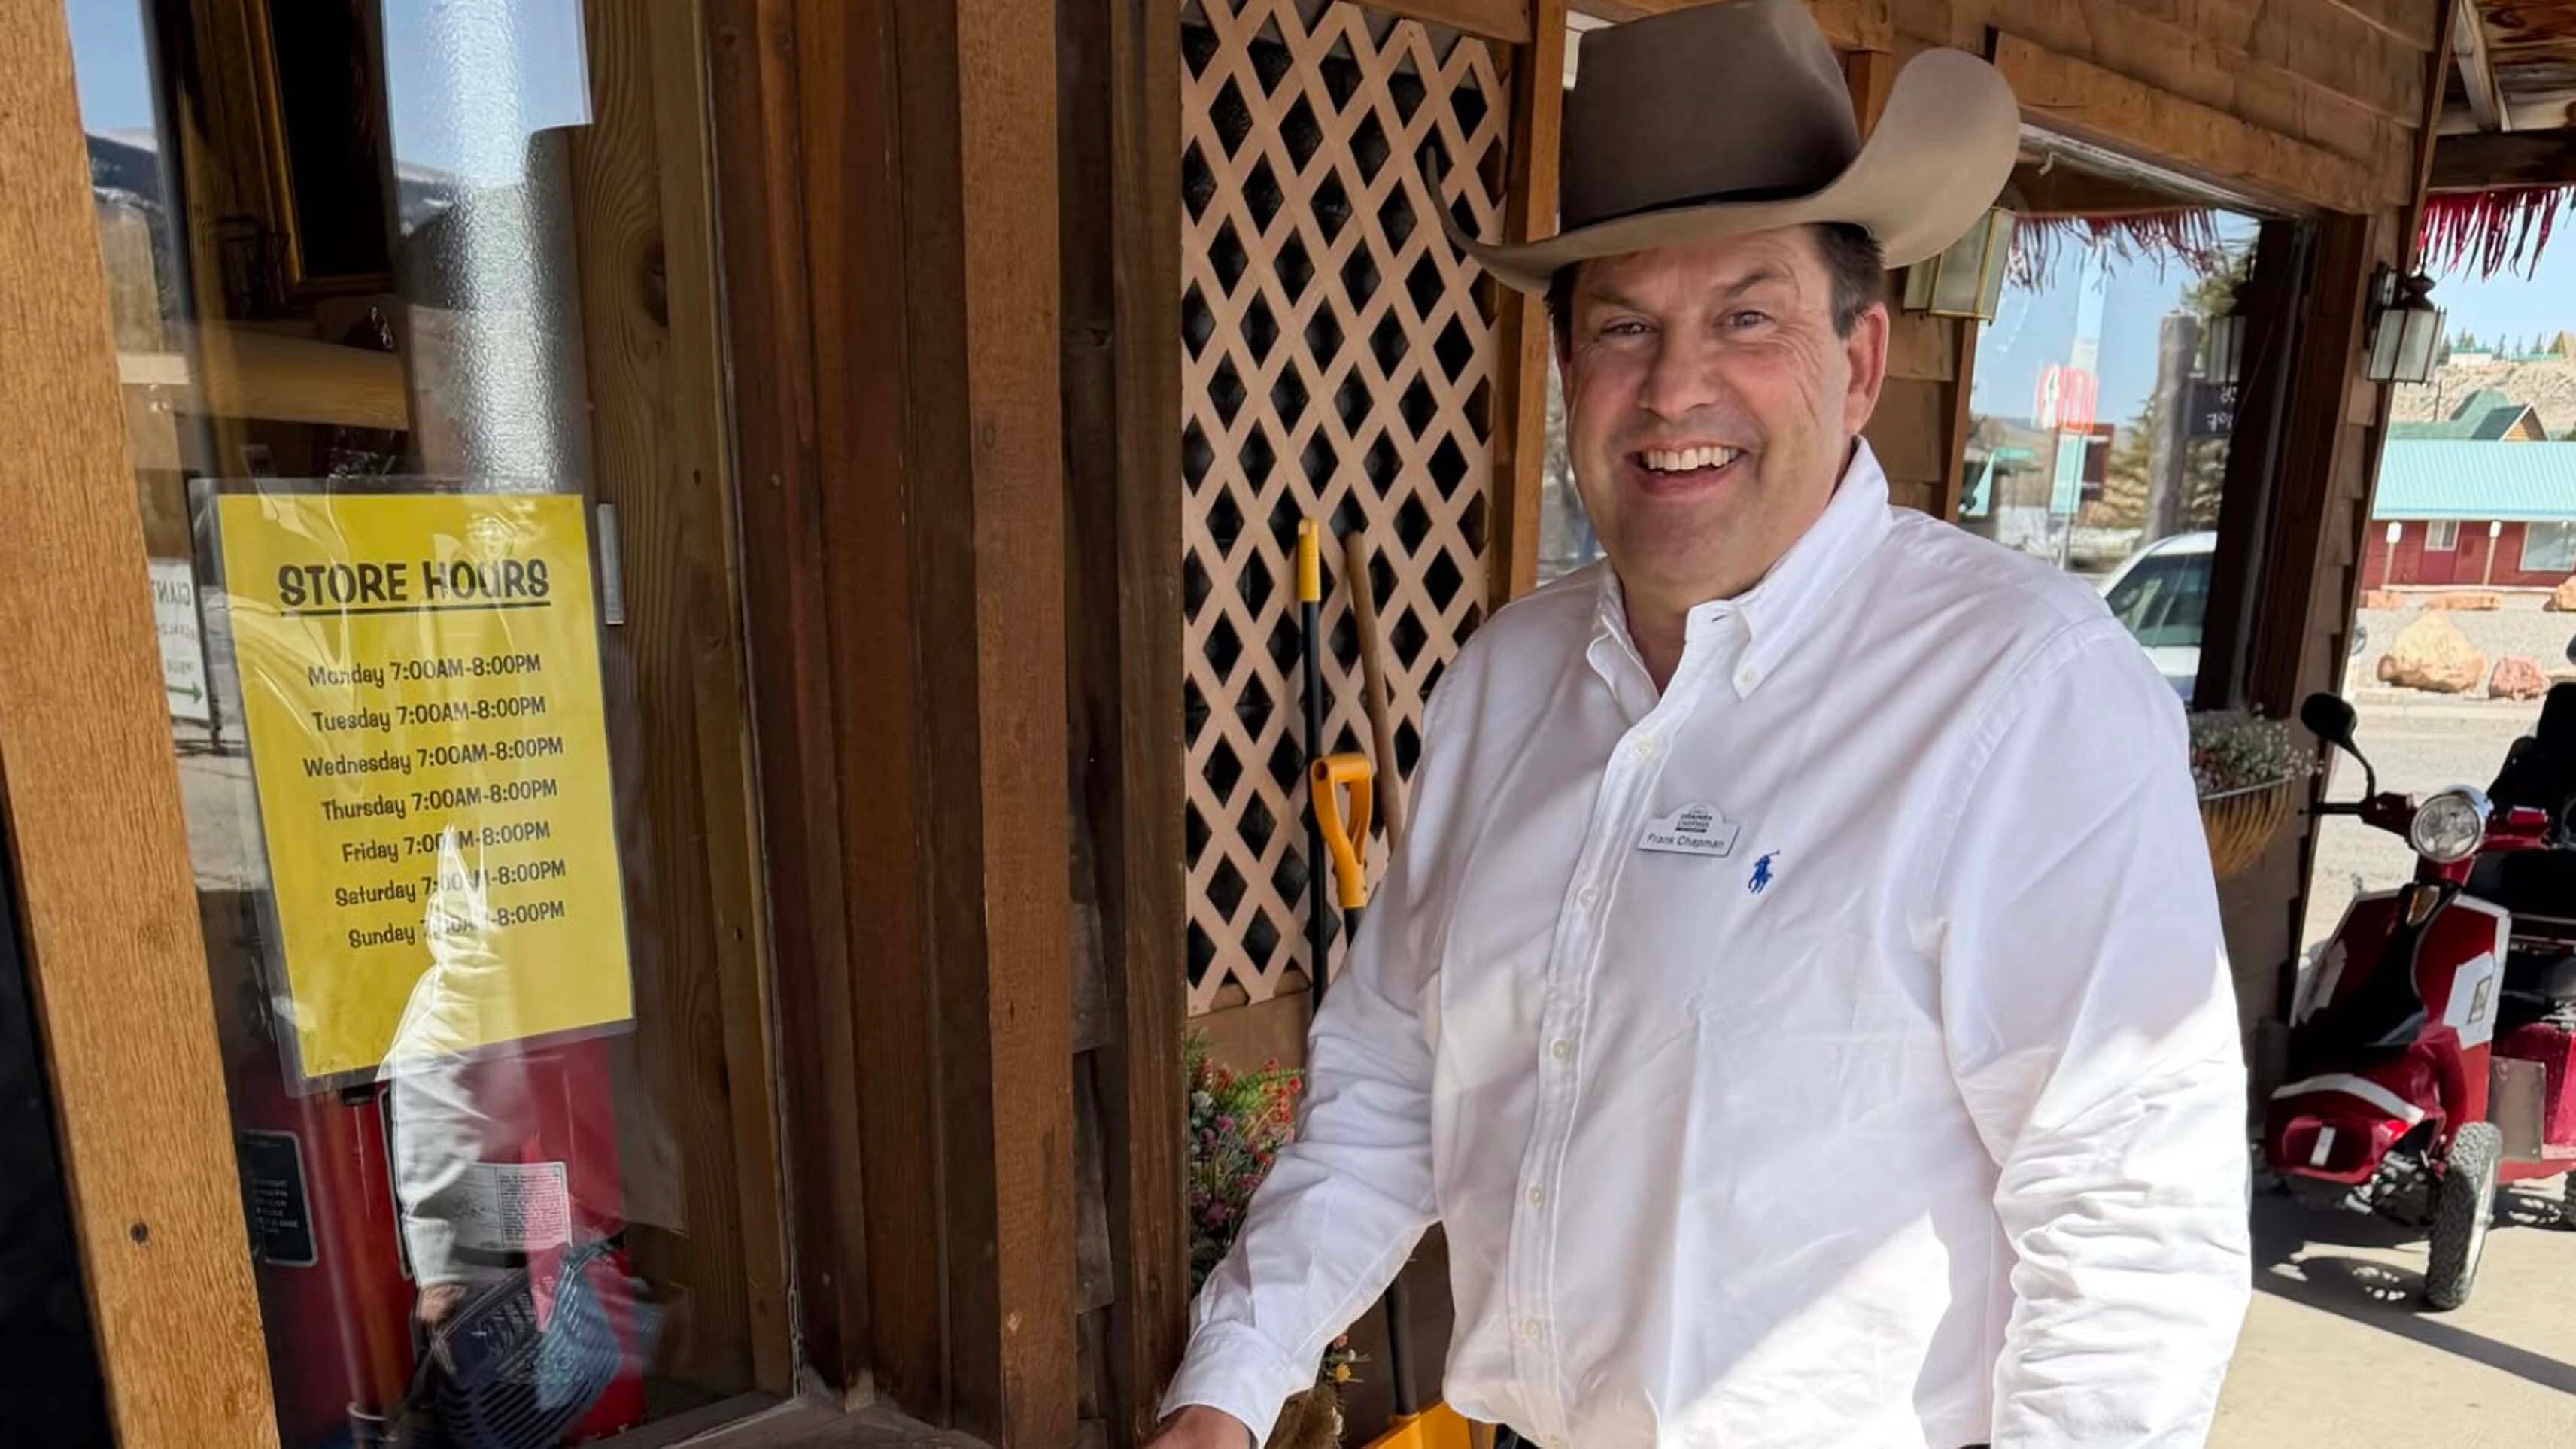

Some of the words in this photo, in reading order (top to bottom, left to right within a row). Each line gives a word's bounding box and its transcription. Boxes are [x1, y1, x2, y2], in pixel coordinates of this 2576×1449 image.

[278, 564, 408, 606] STORE
[421, 558, 549, 600] HOURS
[308, 663, 384, 688] Monday
[390, 654, 541, 681] 7:00AM-8:00PM
[312, 707, 391, 733] Tuesday
[396, 696, 545, 725] 7:00AM-8:00PM
[303, 750, 411, 777] Wednesday
[416, 737, 564, 768] 7:00AM-8:00PM
[322, 795, 406, 821] Thursday
[412, 779, 557, 812] 7:00AM-8:00PM
[342, 839, 399, 863] Friday
[403, 821, 550, 855] 7:00M-8:00PM
[1647, 833, 1675, 844] Frank
[1677, 835, 1725, 849] Chapman
[335, 882, 417, 908] Saturday
[348, 922, 416, 949] Sunday
